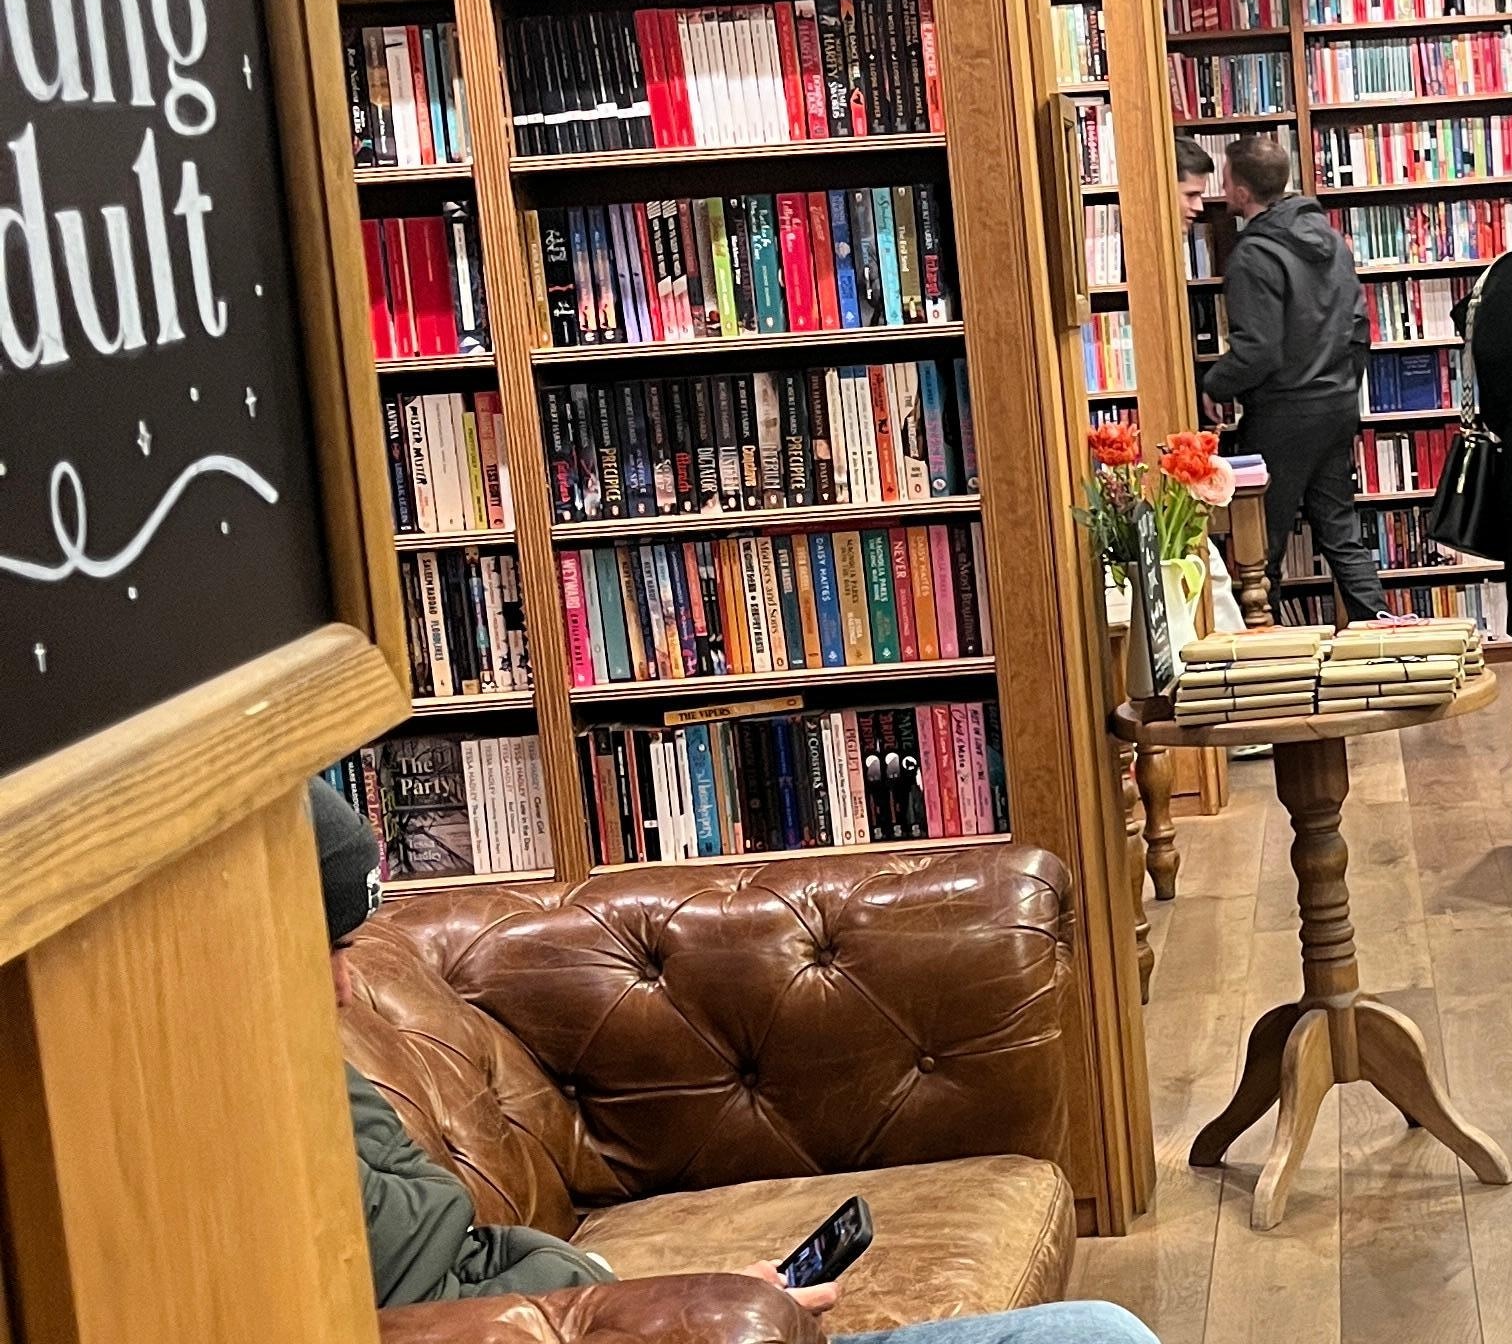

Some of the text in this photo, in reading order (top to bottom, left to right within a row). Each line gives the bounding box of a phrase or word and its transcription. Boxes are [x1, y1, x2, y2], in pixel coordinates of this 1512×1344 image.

[923, 31, 937, 77] MERCIES
[386, 404, 399, 439] LAVINIA
[548, 394, 562, 452] ROBERT HARRIS
[487, 464, 498, 482] TESS
[600, 448, 621, 502] PRECIPICE
[786, 436, 805, 490] PRECIPICE
[423, 559, 434, 586] SALEEM
[562, 559, 580, 609] WEYWARD
[815, 537, 831, 602] DAISY HAITES
[875, 537, 888, 602] MAGNOLIA PARKS
[646, 579, 656, 602] HARUF
[760, 540, 780, 634] Mothers and Sons
[677, 706, 732, 722] THE VIPERS
[879, 712, 894, 750] BRIDE
[401, 756, 434, 775] The
[464, 747, 474, 769] TESSA
[514, 743, 523, 766] TESSA
[527, 741, 536, 762] TESSA
[846, 728, 860, 774] PIGLET
[484, 745, 496, 795] TESSA HADLEY
[517, 767, 526, 797] HADLEY
[365, 771, 378, 802] Free
[400, 777, 450, 799] Party
[468, 771, 478, 801] HADLEY
[471, 804, 479, 815] The
[533, 796, 542, 820] Clever
[536, 821, 545, 834] Girl
